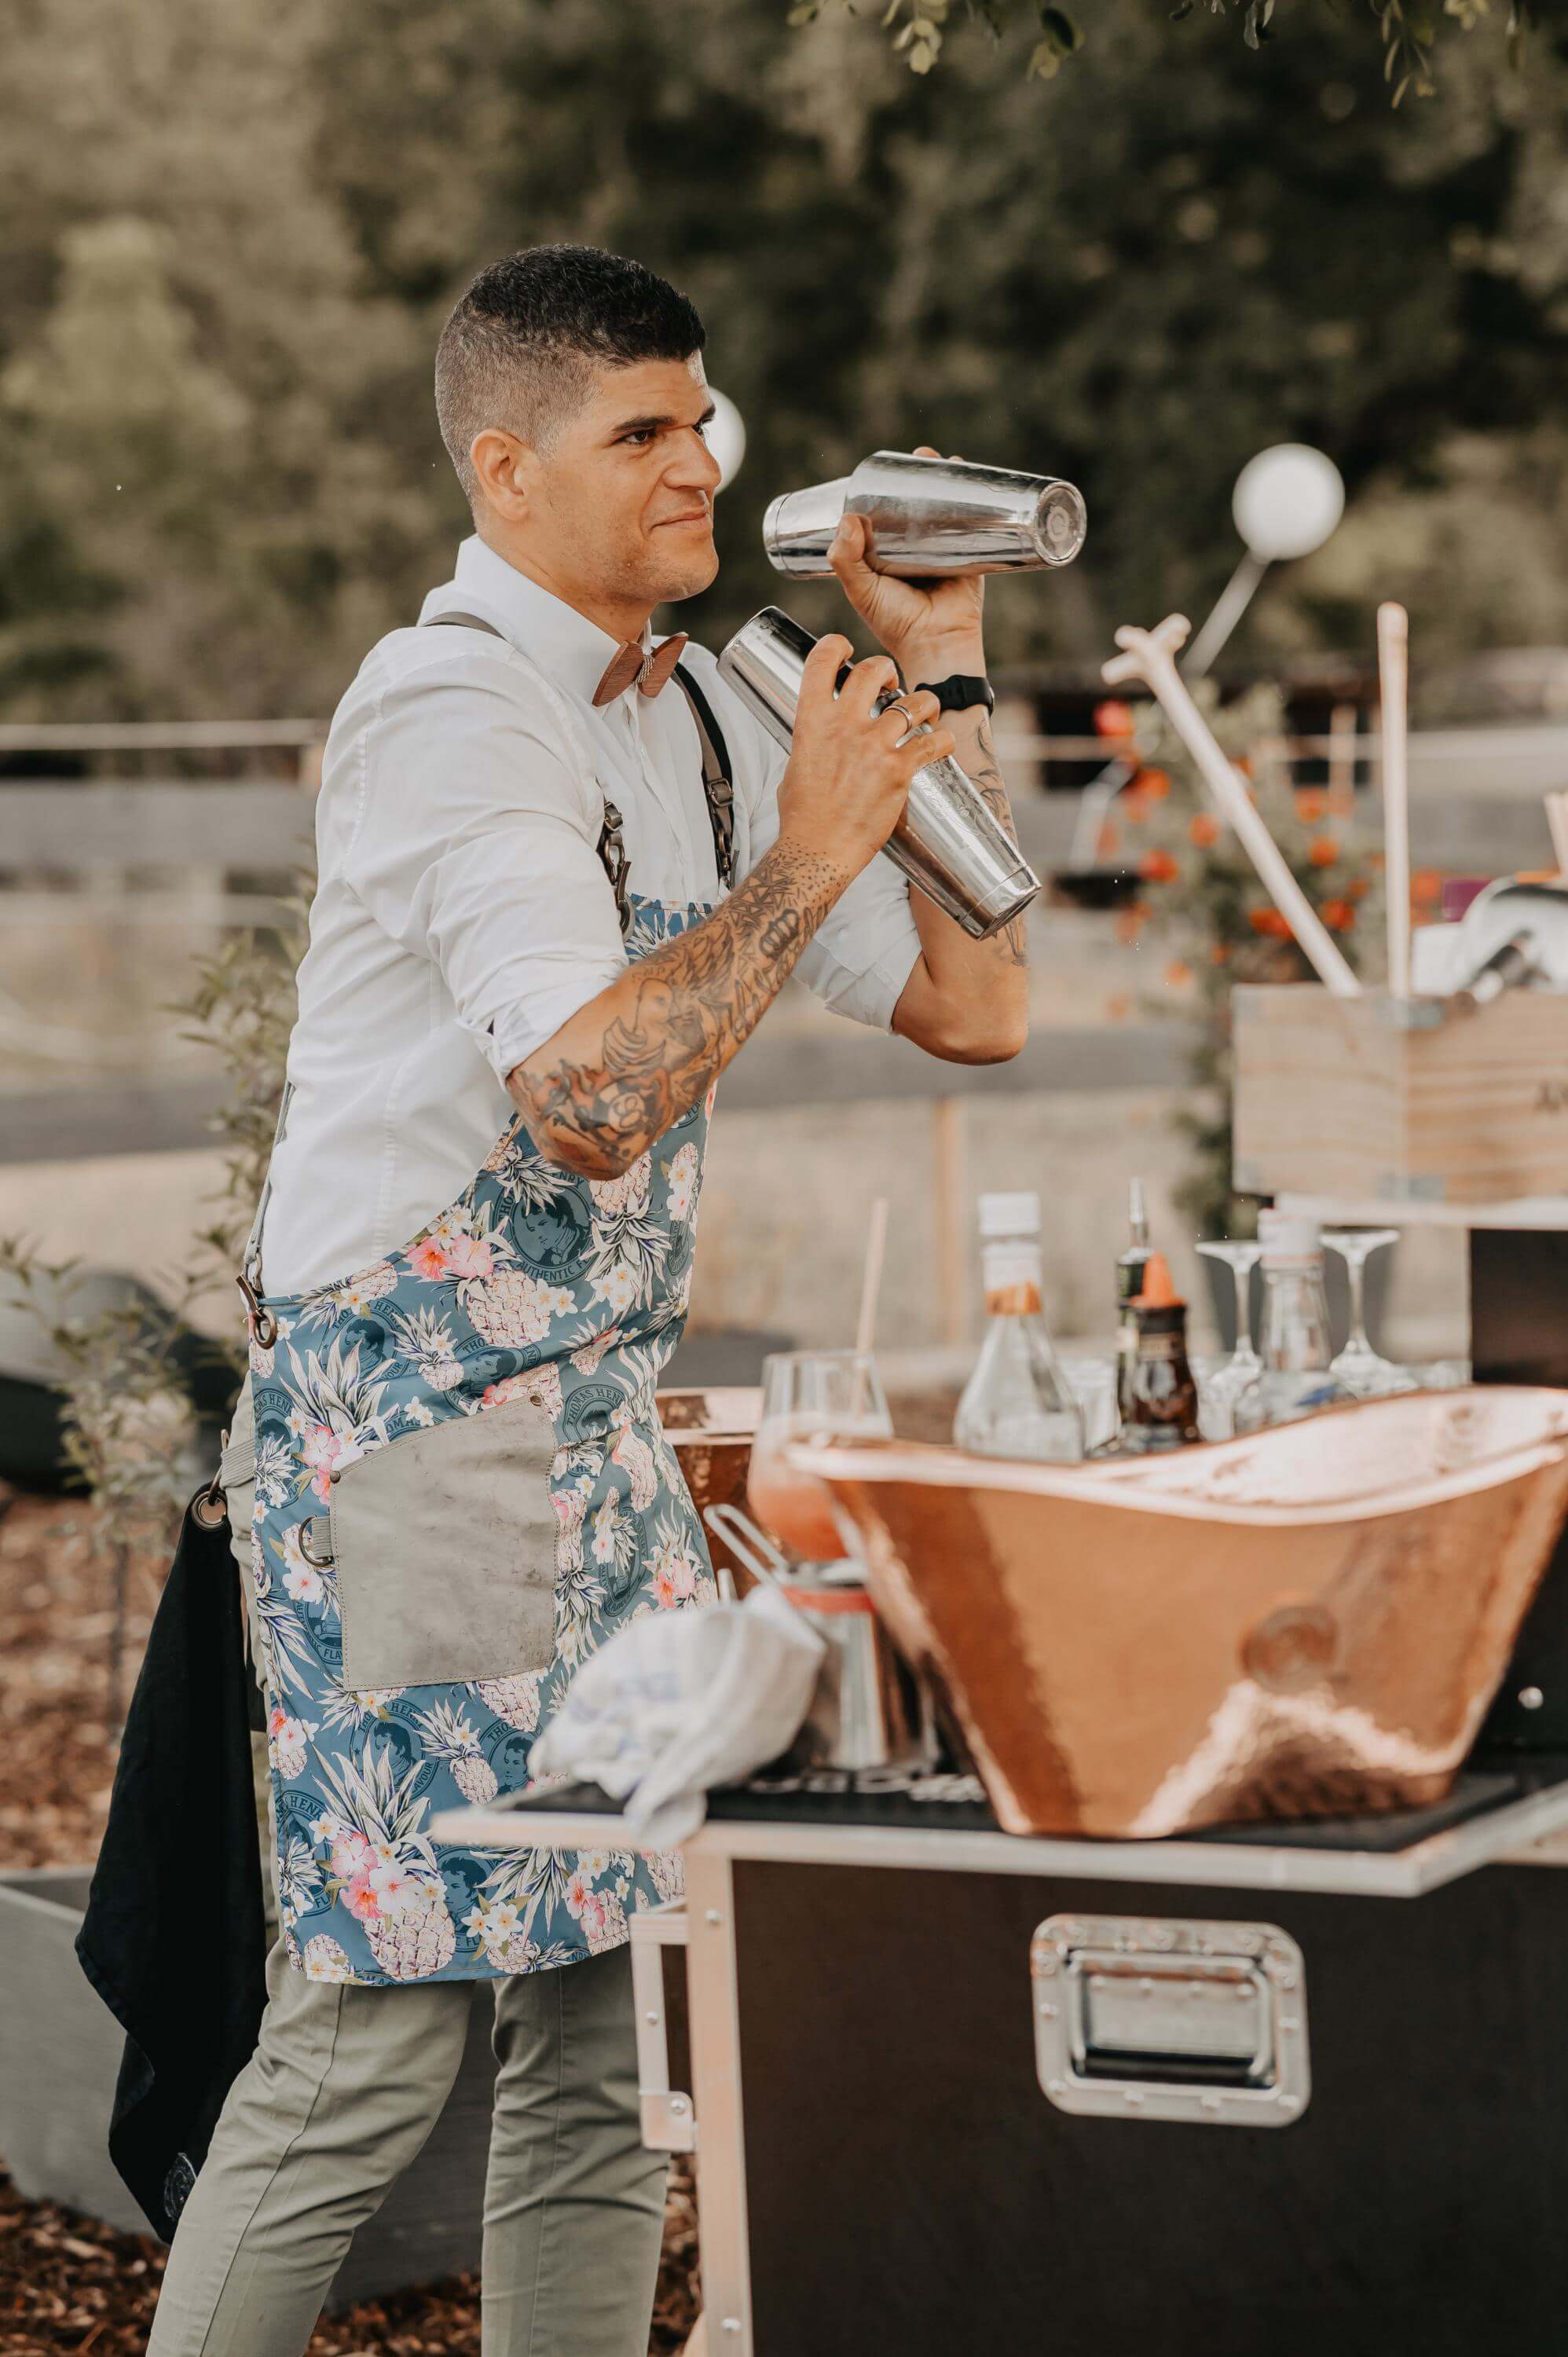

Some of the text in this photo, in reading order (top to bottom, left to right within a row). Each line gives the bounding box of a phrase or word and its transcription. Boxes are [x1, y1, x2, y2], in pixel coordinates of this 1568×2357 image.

[516, 1261, 576, 1280] AUTHENTIC
[566, 1389, 595, 1426] THOMAS
[486, 1721, 510, 1743] THO
